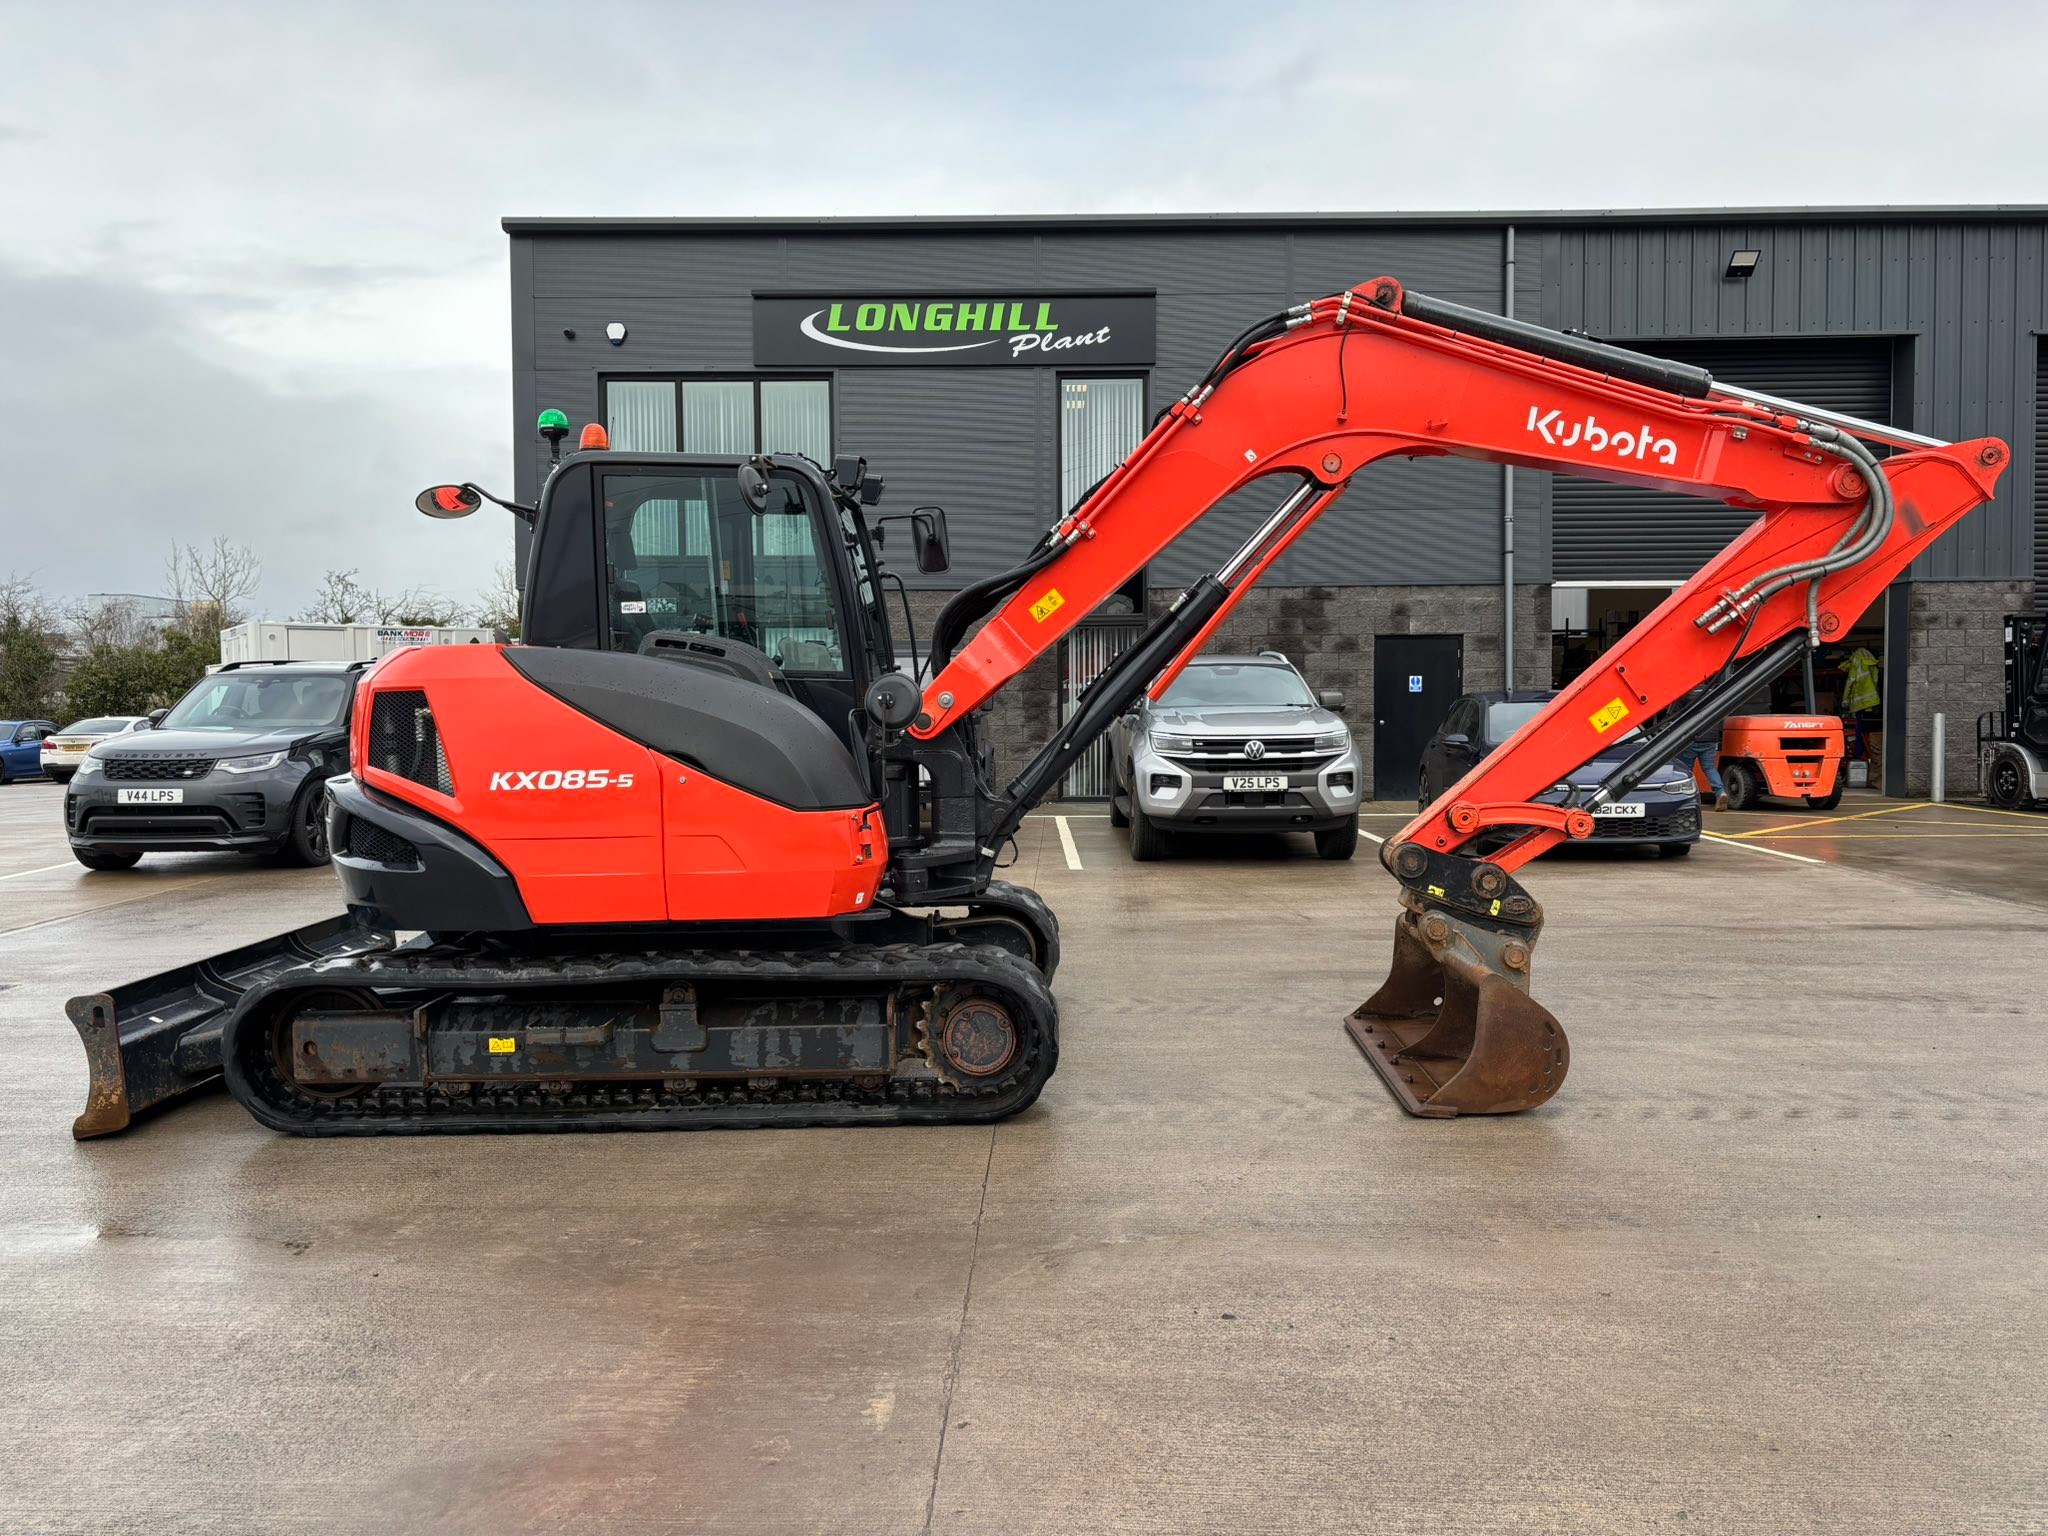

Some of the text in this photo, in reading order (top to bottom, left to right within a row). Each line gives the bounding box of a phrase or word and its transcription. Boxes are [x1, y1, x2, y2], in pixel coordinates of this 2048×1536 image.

[826, 302, 1059, 332] LONGHILL
[1008, 326, 1111, 358] Plant
[1526, 405, 1678, 465] Kubota
[489, 769, 635, 791] KX085-5
[1231, 778, 1280, 788] V25 LPS
[126, 791, 174, 801] V44 LPS
[1614, 806, 1637, 814] CKX
